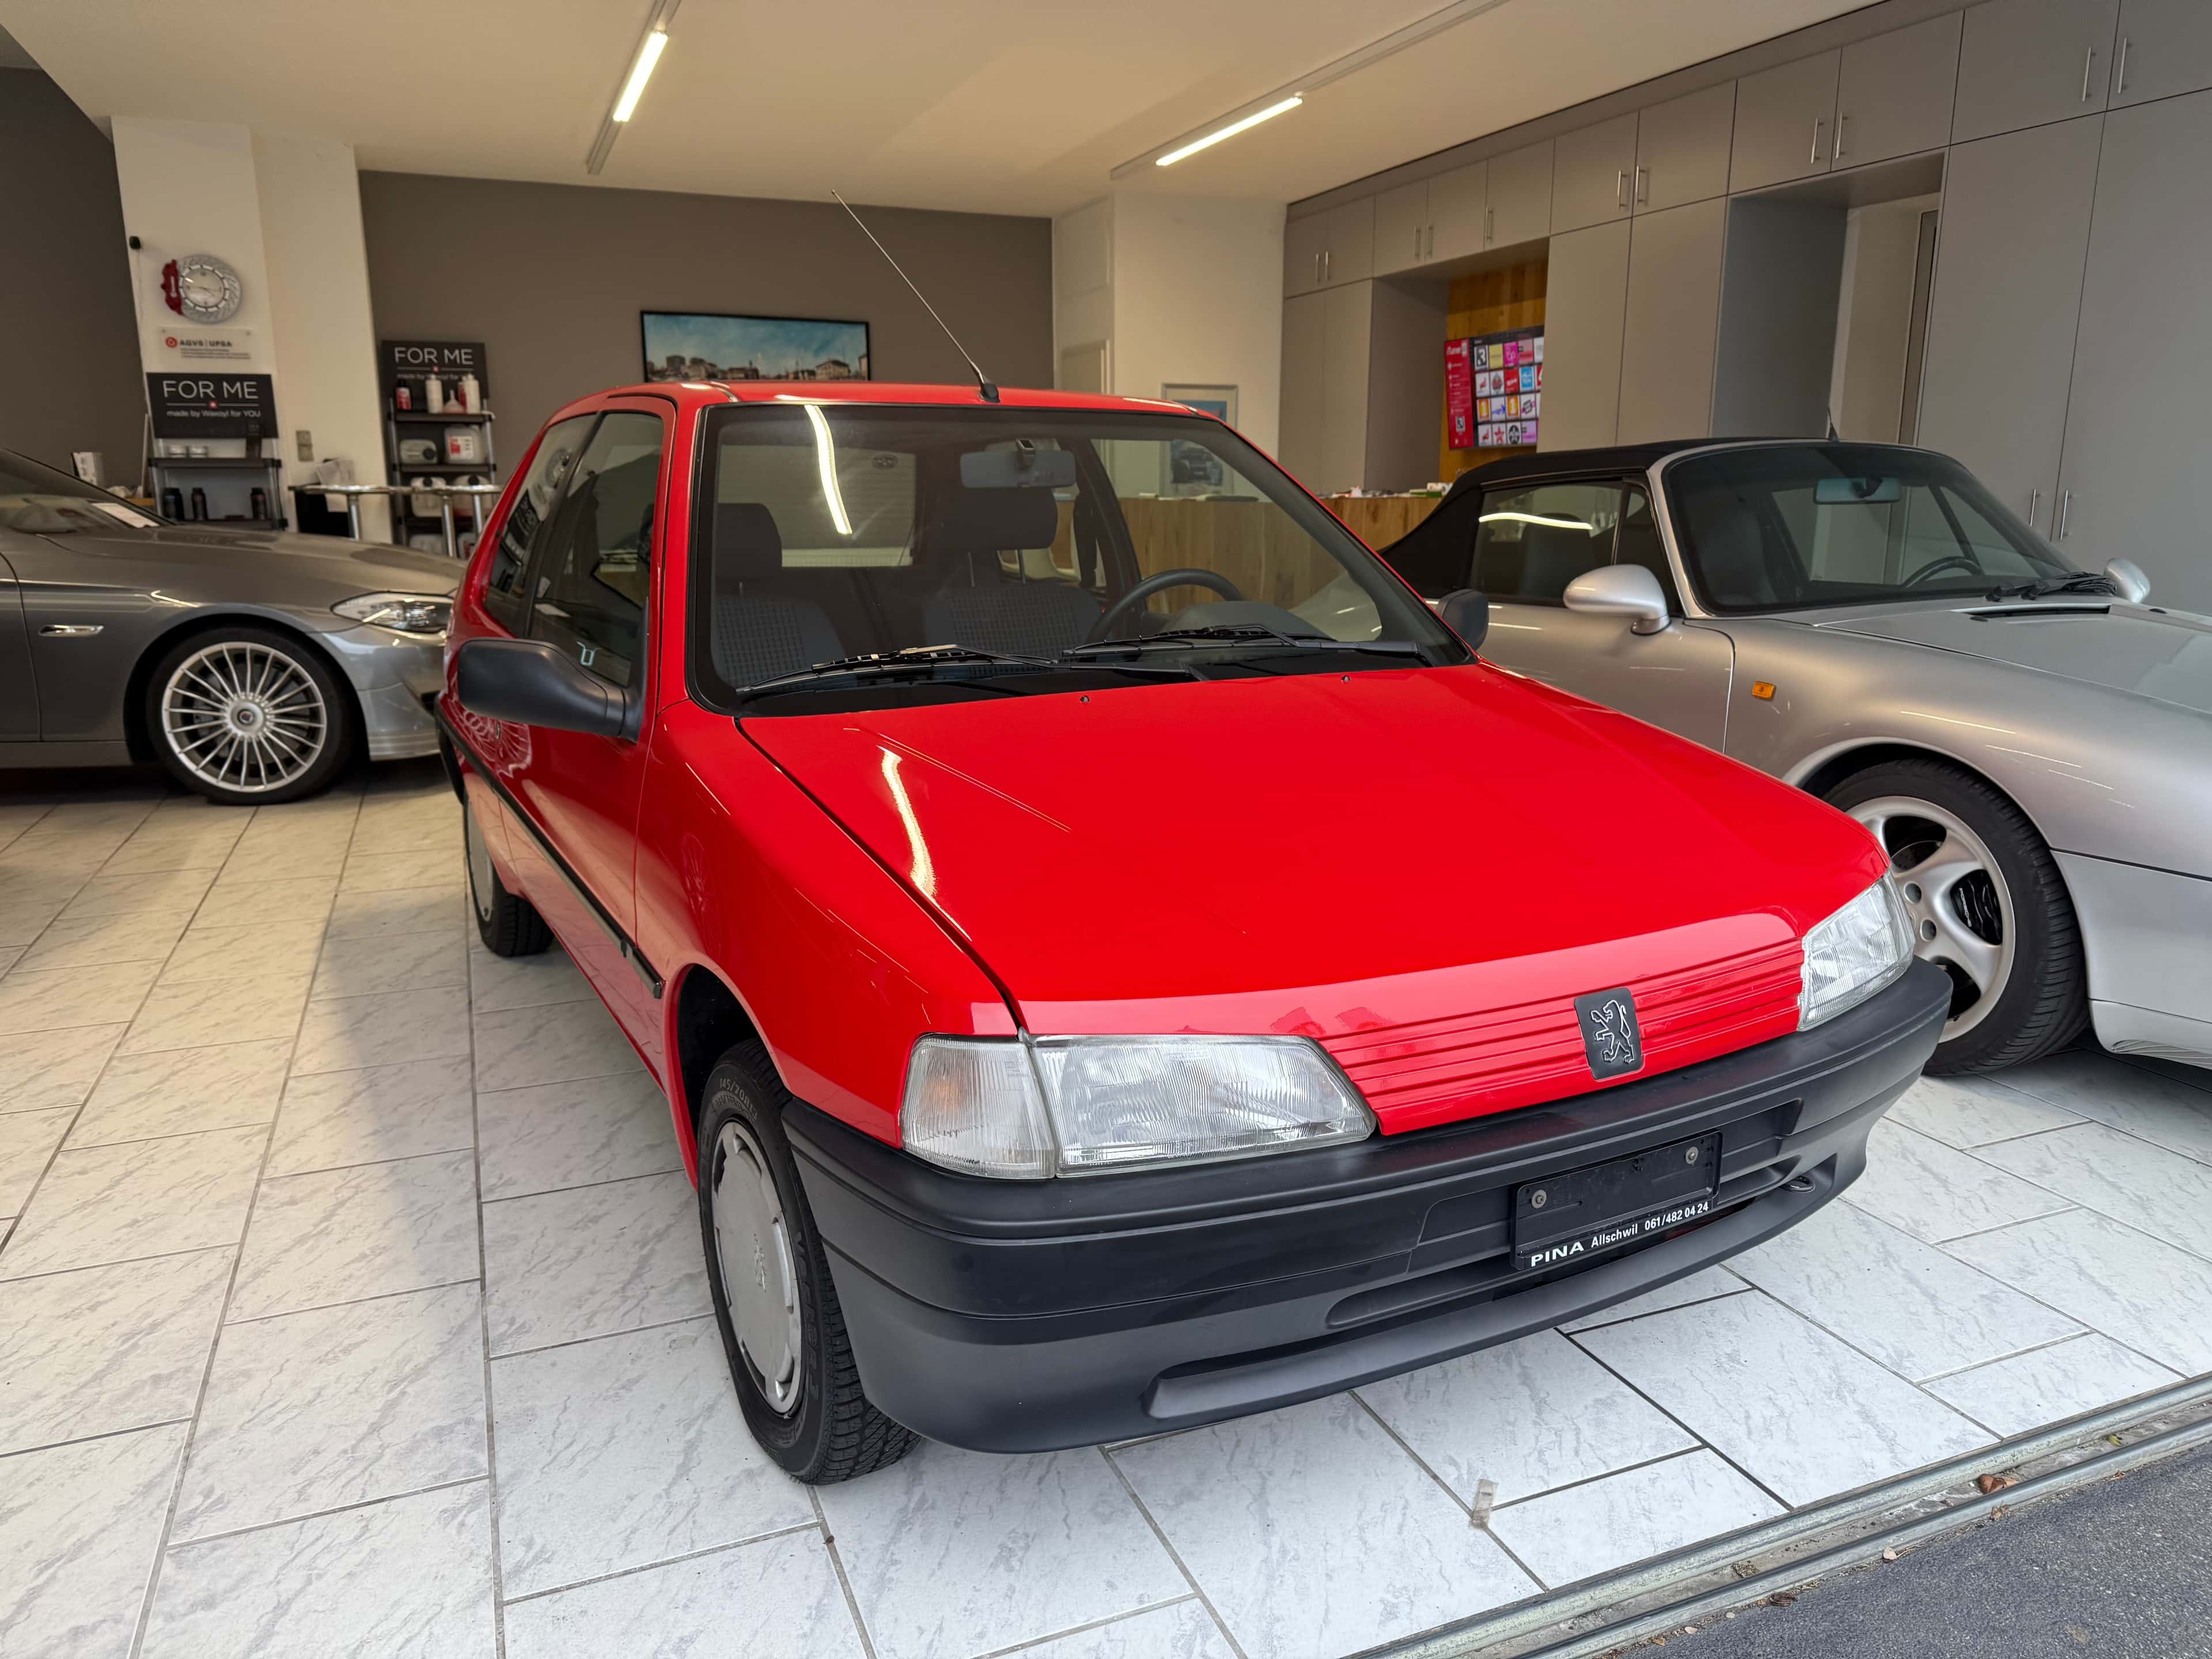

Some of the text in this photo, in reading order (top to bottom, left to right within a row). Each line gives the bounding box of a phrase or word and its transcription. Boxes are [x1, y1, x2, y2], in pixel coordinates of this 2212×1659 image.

[395, 347, 474, 365] FOR ME
[162, 380, 259, 399] FOR ME
[1531, 1202, 1709, 1267] PINA Allschwil 061/482 04 24
